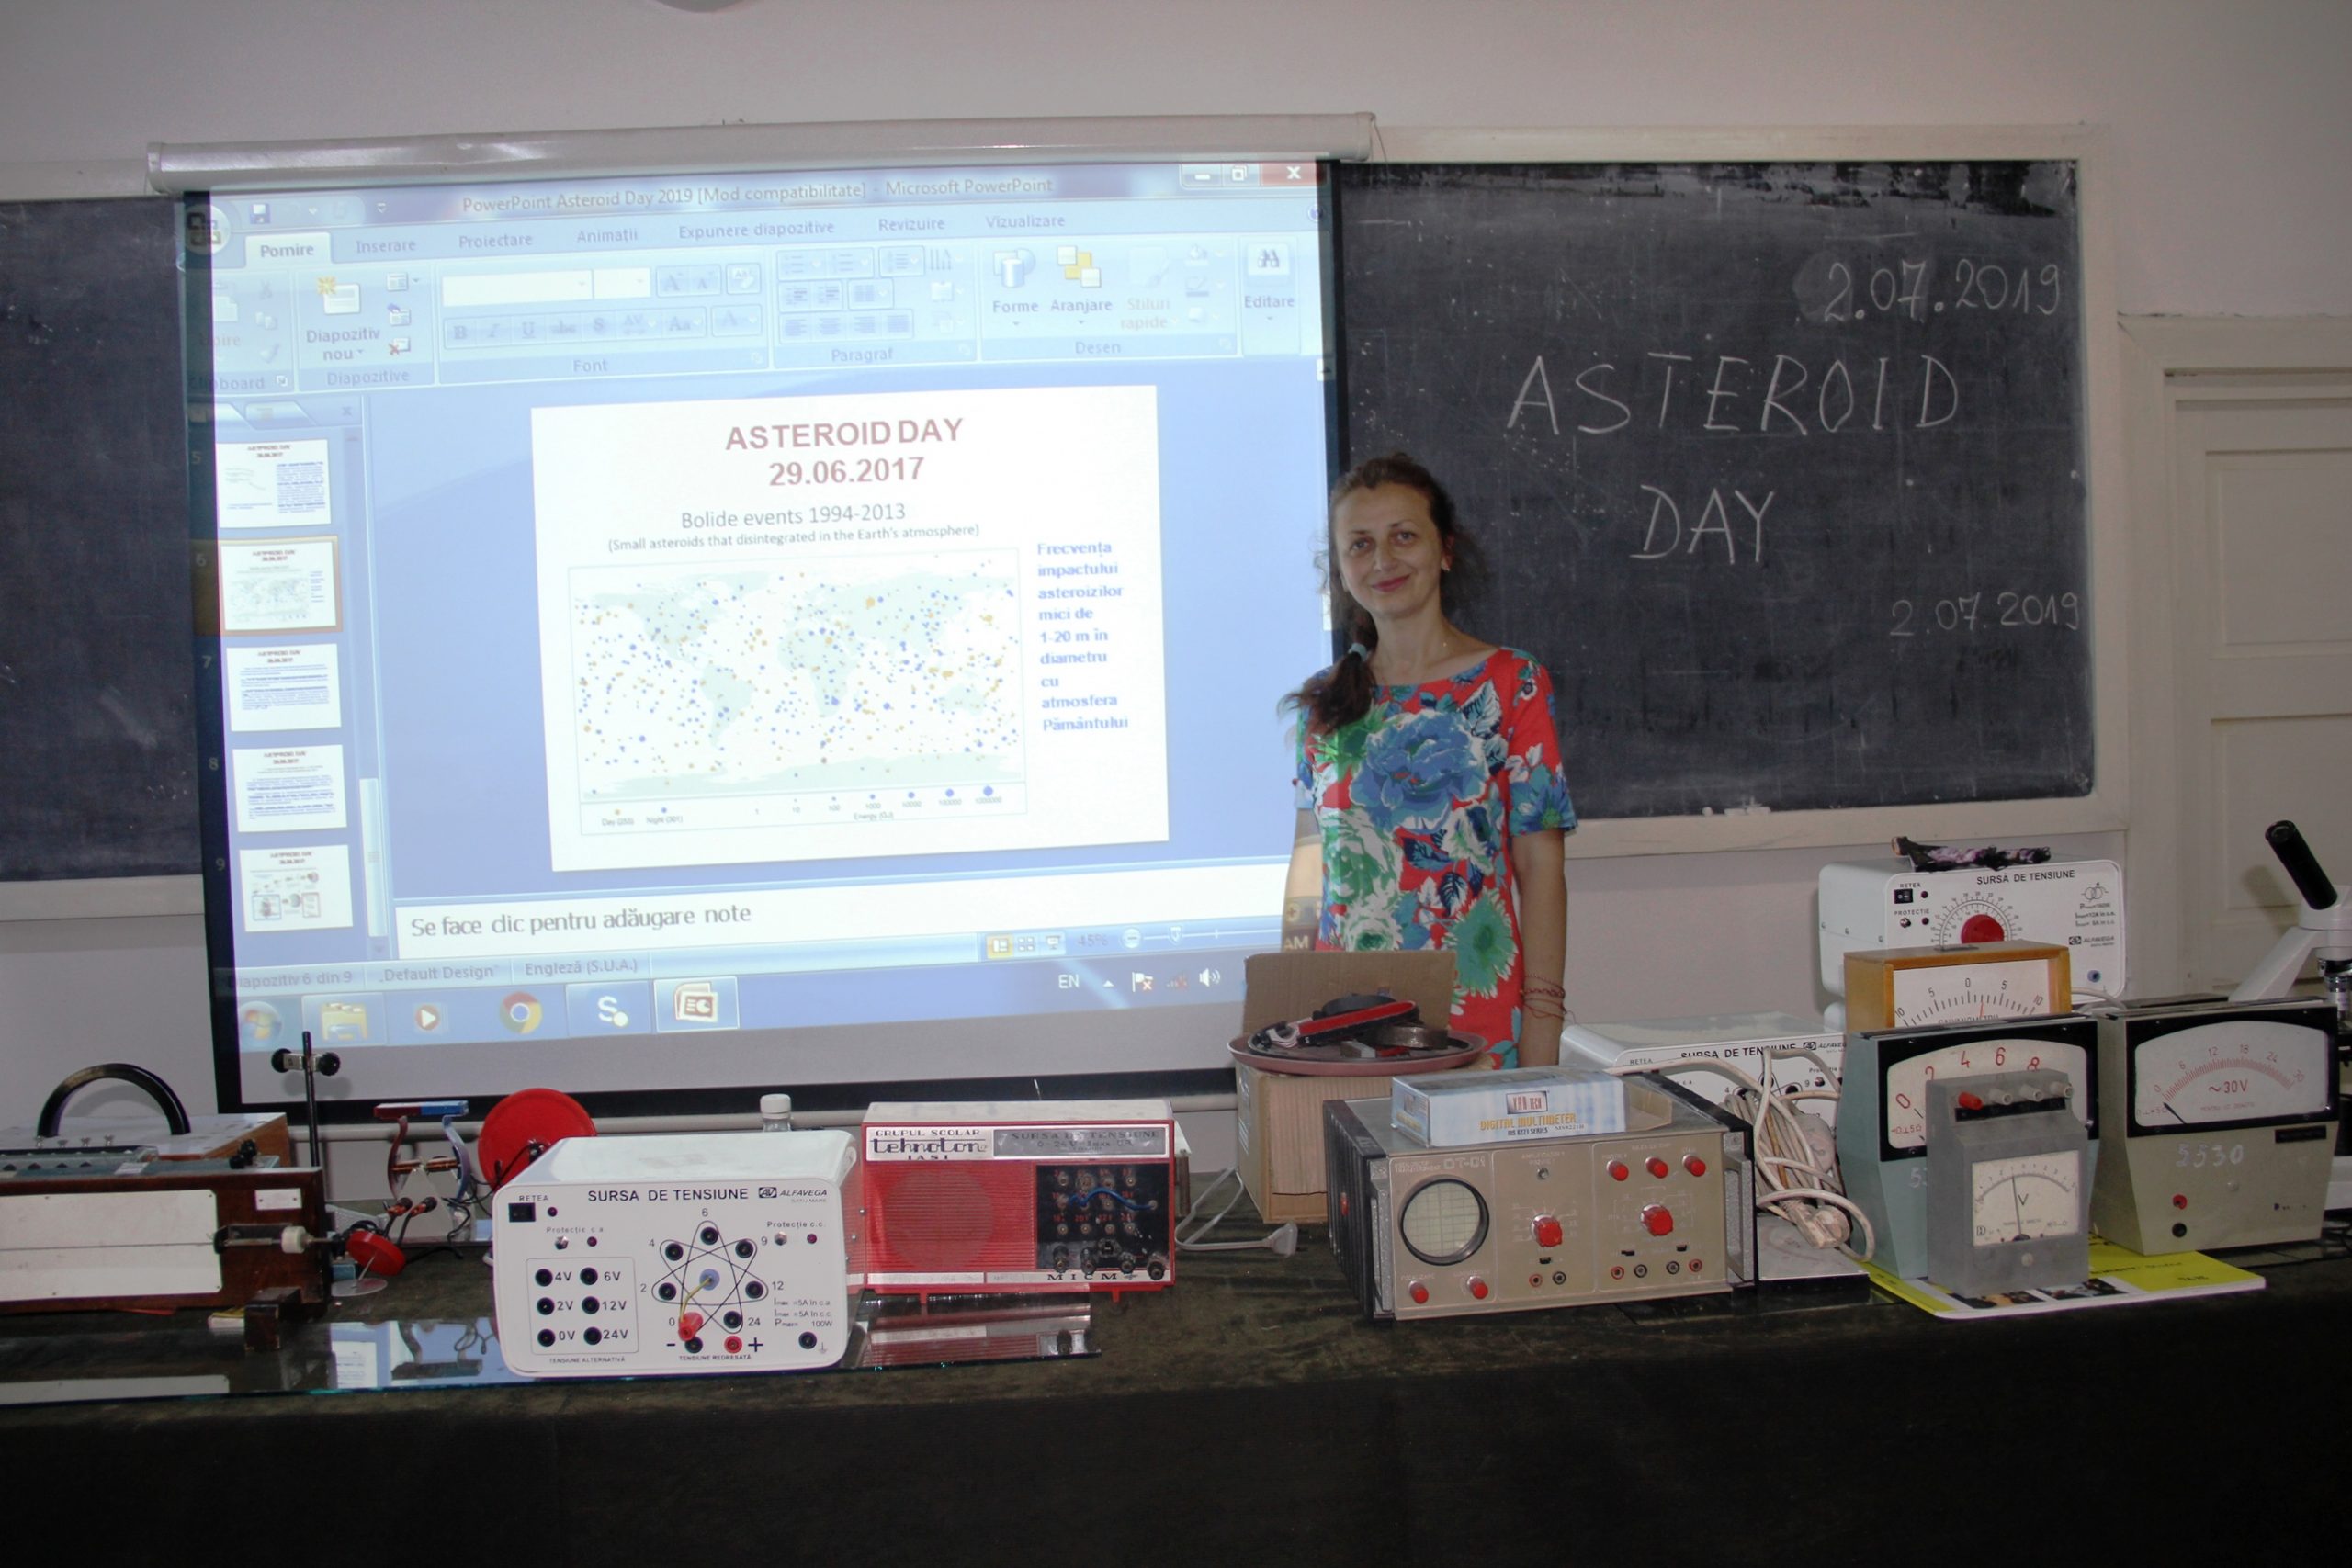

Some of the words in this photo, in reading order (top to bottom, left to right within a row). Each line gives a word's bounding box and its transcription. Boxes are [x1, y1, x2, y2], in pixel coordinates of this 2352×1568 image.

[463, 195, 551, 213] PowerPoint
[557, 191, 620, 209] Asteroid
[625, 190, 653, 207] Day
[658, 187, 692, 204] 2019
[697, 186, 741, 205] [Mod
[744, 182, 866, 205] compatibilitate]
[886, 178, 960, 197] Microsoft
[965, 177, 1053, 196] PowerPoint
[878, 217, 945, 232] Revizuire
[985, 214, 1066, 230] Vizualizare
[679, 223, 749, 241] Expunere
[753, 219, 834, 238] diapozitive
[356, 239, 416, 254] Inserare
[459, 233, 533, 250] Proiectare
[1824, 258, 2061, 323] 2.07.2019
[992, 299, 1039, 314] Forme
[1050, 299, 1114, 316] Aranjare
[1243, 294, 1295, 310] Editare
[306, 328, 381, 345] Diapozitiv
[1075, 339, 1121, 355] Desen
[322, 349, 354, 361] nou
[831, 347, 893, 365] Paragraf
[572, 358, 609, 373] Font
[326, 370, 411, 387] Diapozitive
[1508, 351, 1959, 436] ASTEROID
[725, 420, 892, 451] ASTEROID
[898, 416, 965, 445] DAY
[768, 456, 926, 487] 29.06.2017
[681, 508, 739, 530] Bolide
[743, 508, 804, 527] events
[808, 502, 906, 525] 1994-2013
[1629, 483, 1775, 566] DAY
[608, 537, 646, 554] (Small
[649, 534, 705, 551] asteroids
[707, 533, 733, 548] that
[736, 529, 817, 549] disintegrated
[819, 529, 831, 543] in
[832, 528, 854, 543] the
[901, 523, 980, 543] atmosphere)
[195, 553, 207, 568] 6
[1037, 561, 1119, 579] impactului
[1038, 584, 1125, 600] asteroizilor
[1038, 607, 1071, 622] mici
[1074, 606, 1094, 620] de
[1075, 631, 1090, 642] m
[201, 655, 213, 670] 7
[1040, 650, 1108, 665] diametru
[1040, 676, 1060, 688] cu
[1041, 694, 1119, 709] atmosfera
[208, 757, 220, 772] 8
[1976, 874, 2009, 886] SURSA
[2014, 874, 2027, 883] DE
[2030, 870, 2075, 881] TENSIUNE
[411, 918, 436, 937] Se
[442, 915, 482, 936] face
[530, 911, 596, 935] pentru
[603, 907, 695, 931] adăugare
[705, 904, 752, 924] note
[302, 971, 312, 986] 6
[316, 970, 340, 985] din
[343, 969, 353, 984] 9
[1058, 973, 1080, 990] EN
[1895, 1007, 1905, 1019] 10
[1928, 987, 1935, 998] 5
[1964, 977, 1972, 988] 0
[2001, 980, 2007, 991] 5
[2033, 994, 2044, 1006] 10
[1724, 1048, 1742, 1058] DE
[2153, 1084, 2162, 1094] 0
[2178, 1060, 2187, 1071] 6
[2208, 1045, 2219, 1057] 12
[2239, 1043, 2250, 1055] 18
[2266, 1050, 2278, 1064] 24
[1895, 1093, 1911, 1109] 0
[1961, 1050, 1970, 1068] 4
[1996, 1046, 2006, 1066] 6
[1480, 1117, 1514, 1131] DIGITAL
[1518, 1111, 1577, 1129] MULTIMETER
[875, 1129, 926, 1137] GRUPUL
[930, 1128, 981, 1137] SCOLAR
[1531, 1126, 1549, 1134] SERIES
[588, 1190, 640, 1202] SURSA
[648, 1190, 669, 1202] DE
[673, 1188, 750, 1201] TENSIUNE
[779, 1189, 829, 1199] ALFAVEGA
[2018, 1192, 2030, 1206] V
[701, 1207, 710, 1218] 6
[648, 1238, 656, 1247] 4
[761, 1235, 769, 1246] 9
[555, 1270, 572, 1282] 4V
[603, 1270, 622, 1282] 6V
[639, 1282, 647, 1293] 2
[771, 1280, 785, 1292] 12
[556, 1300, 574, 1312] 2V
[601, 1300, 628, 1312] 12V
[668, 1316, 676, 1327] 0
[748, 1317, 762, 1327] 24
[558, 1329, 576, 1341] 0V
[603, 1329, 629, 1340] 24V
